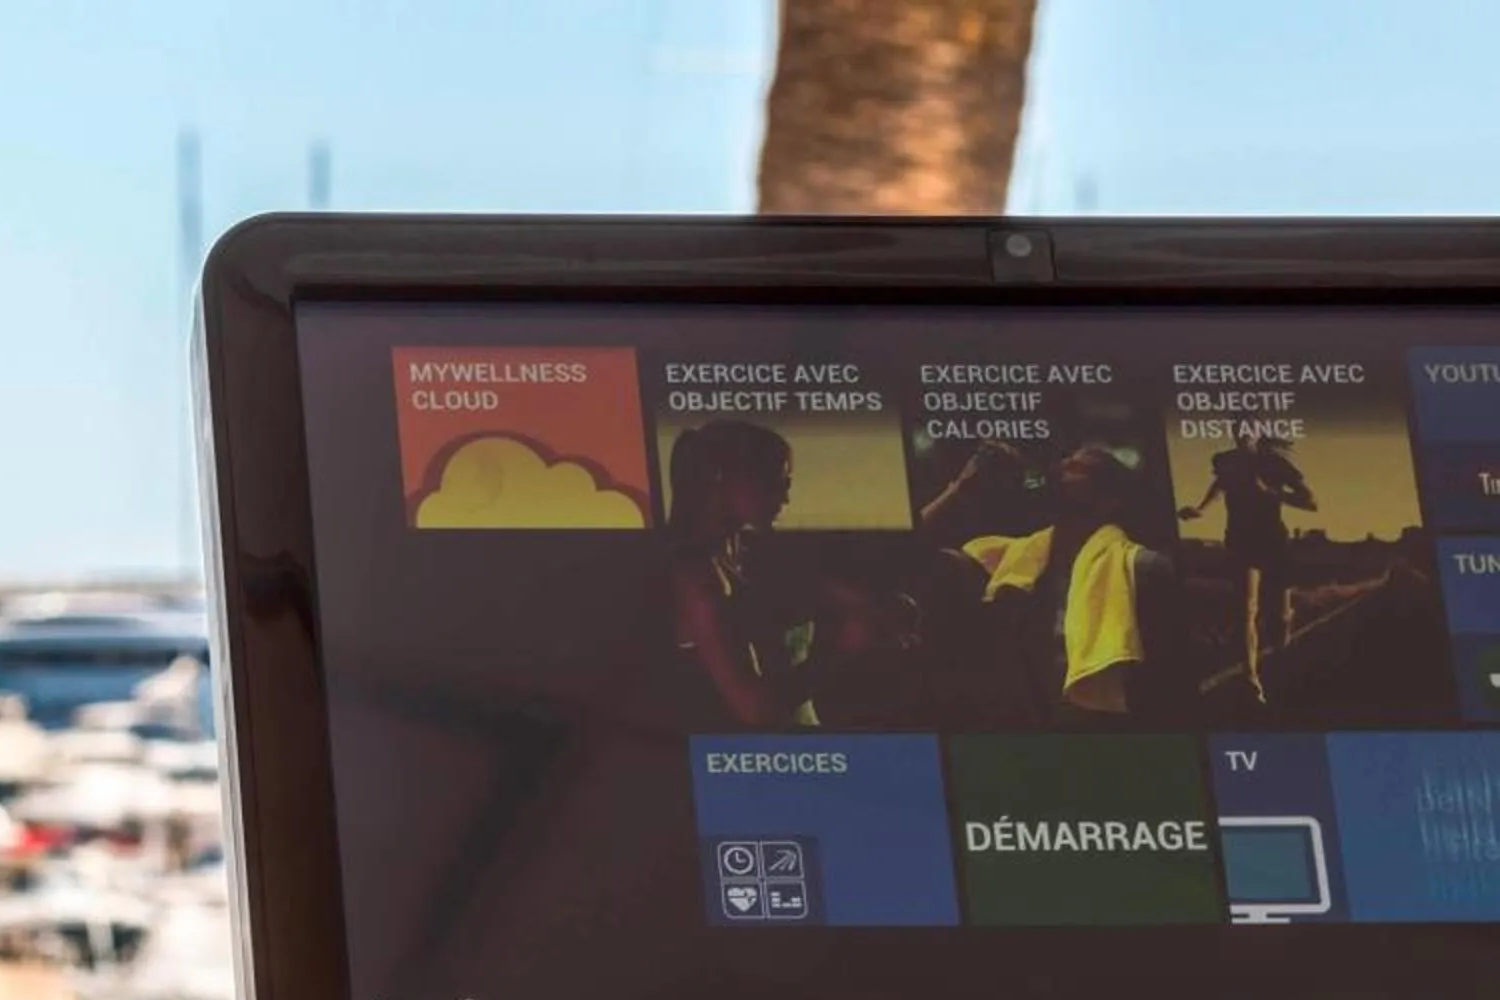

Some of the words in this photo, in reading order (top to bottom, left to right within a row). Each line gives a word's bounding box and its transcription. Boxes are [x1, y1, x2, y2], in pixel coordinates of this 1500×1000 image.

[409, 362, 587, 383] MYWELLNESS
[665, 364, 786, 383] EXERCICE
[793, 364, 859, 384] AVEC
[920, 364, 1041, 384] EXERCICE
[1047, 364, 1112, 384] AVEC
[1173, 364, 1293, 383] EXERCICE
[1299, 364, 1365, 383] AVEC
[412, 390, 499, 410] CLOUD
[669, 391, 787, 411] OBJECTIF
[795, 391, 882, 411] TEMPS
[924, 392, 1041, 411] OBJECTIF
[1177, 391, 1294, 411] OBJECTIF
[926, 419, 1050, 440] CALORIES
[1181, 419, 1305, 440] DISTANCE
[706, 752, 848, 774] EXERCICES
[1224, 750, 1258, 771] TV
[965, 815, 1208, 852] DÉMARRAGE
